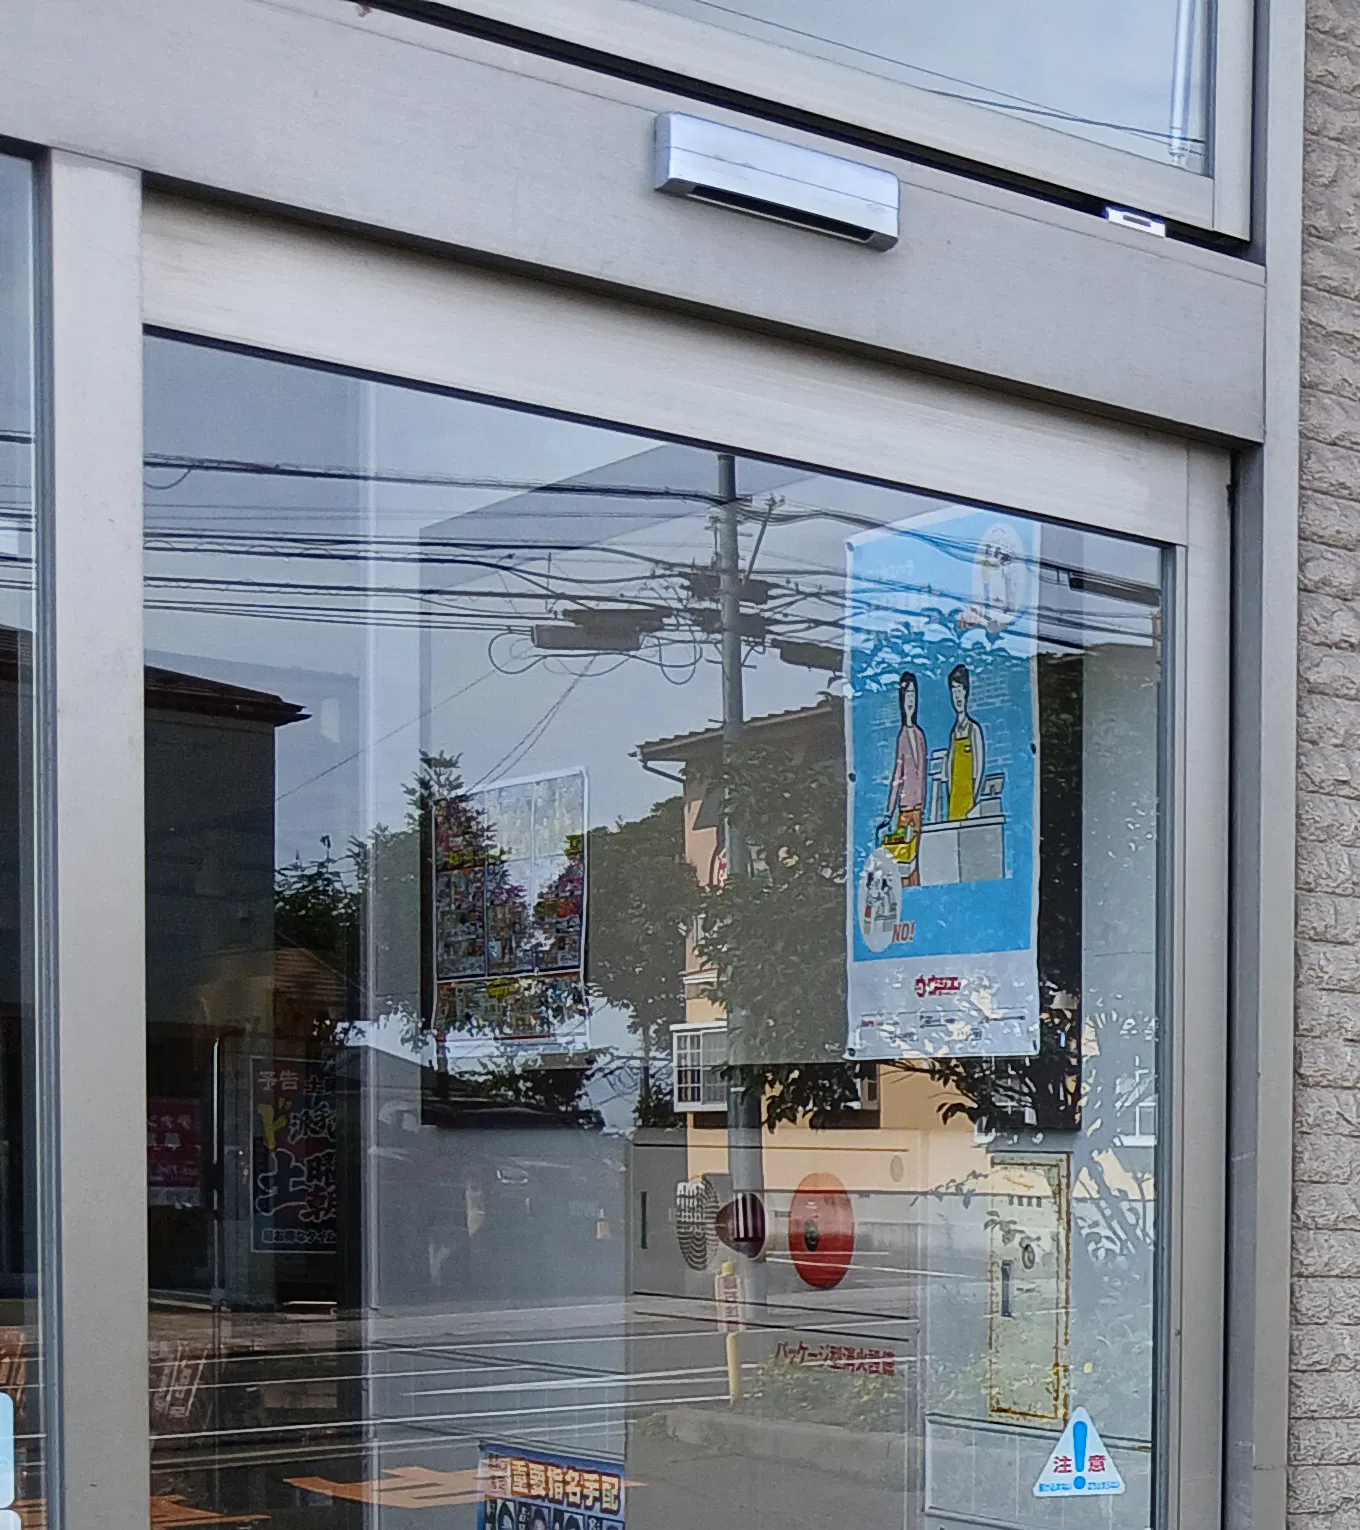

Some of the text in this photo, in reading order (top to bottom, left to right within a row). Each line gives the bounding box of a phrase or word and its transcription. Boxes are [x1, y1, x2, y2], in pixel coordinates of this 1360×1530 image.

[511, 1459, 620, 1512] 重要指名手配
